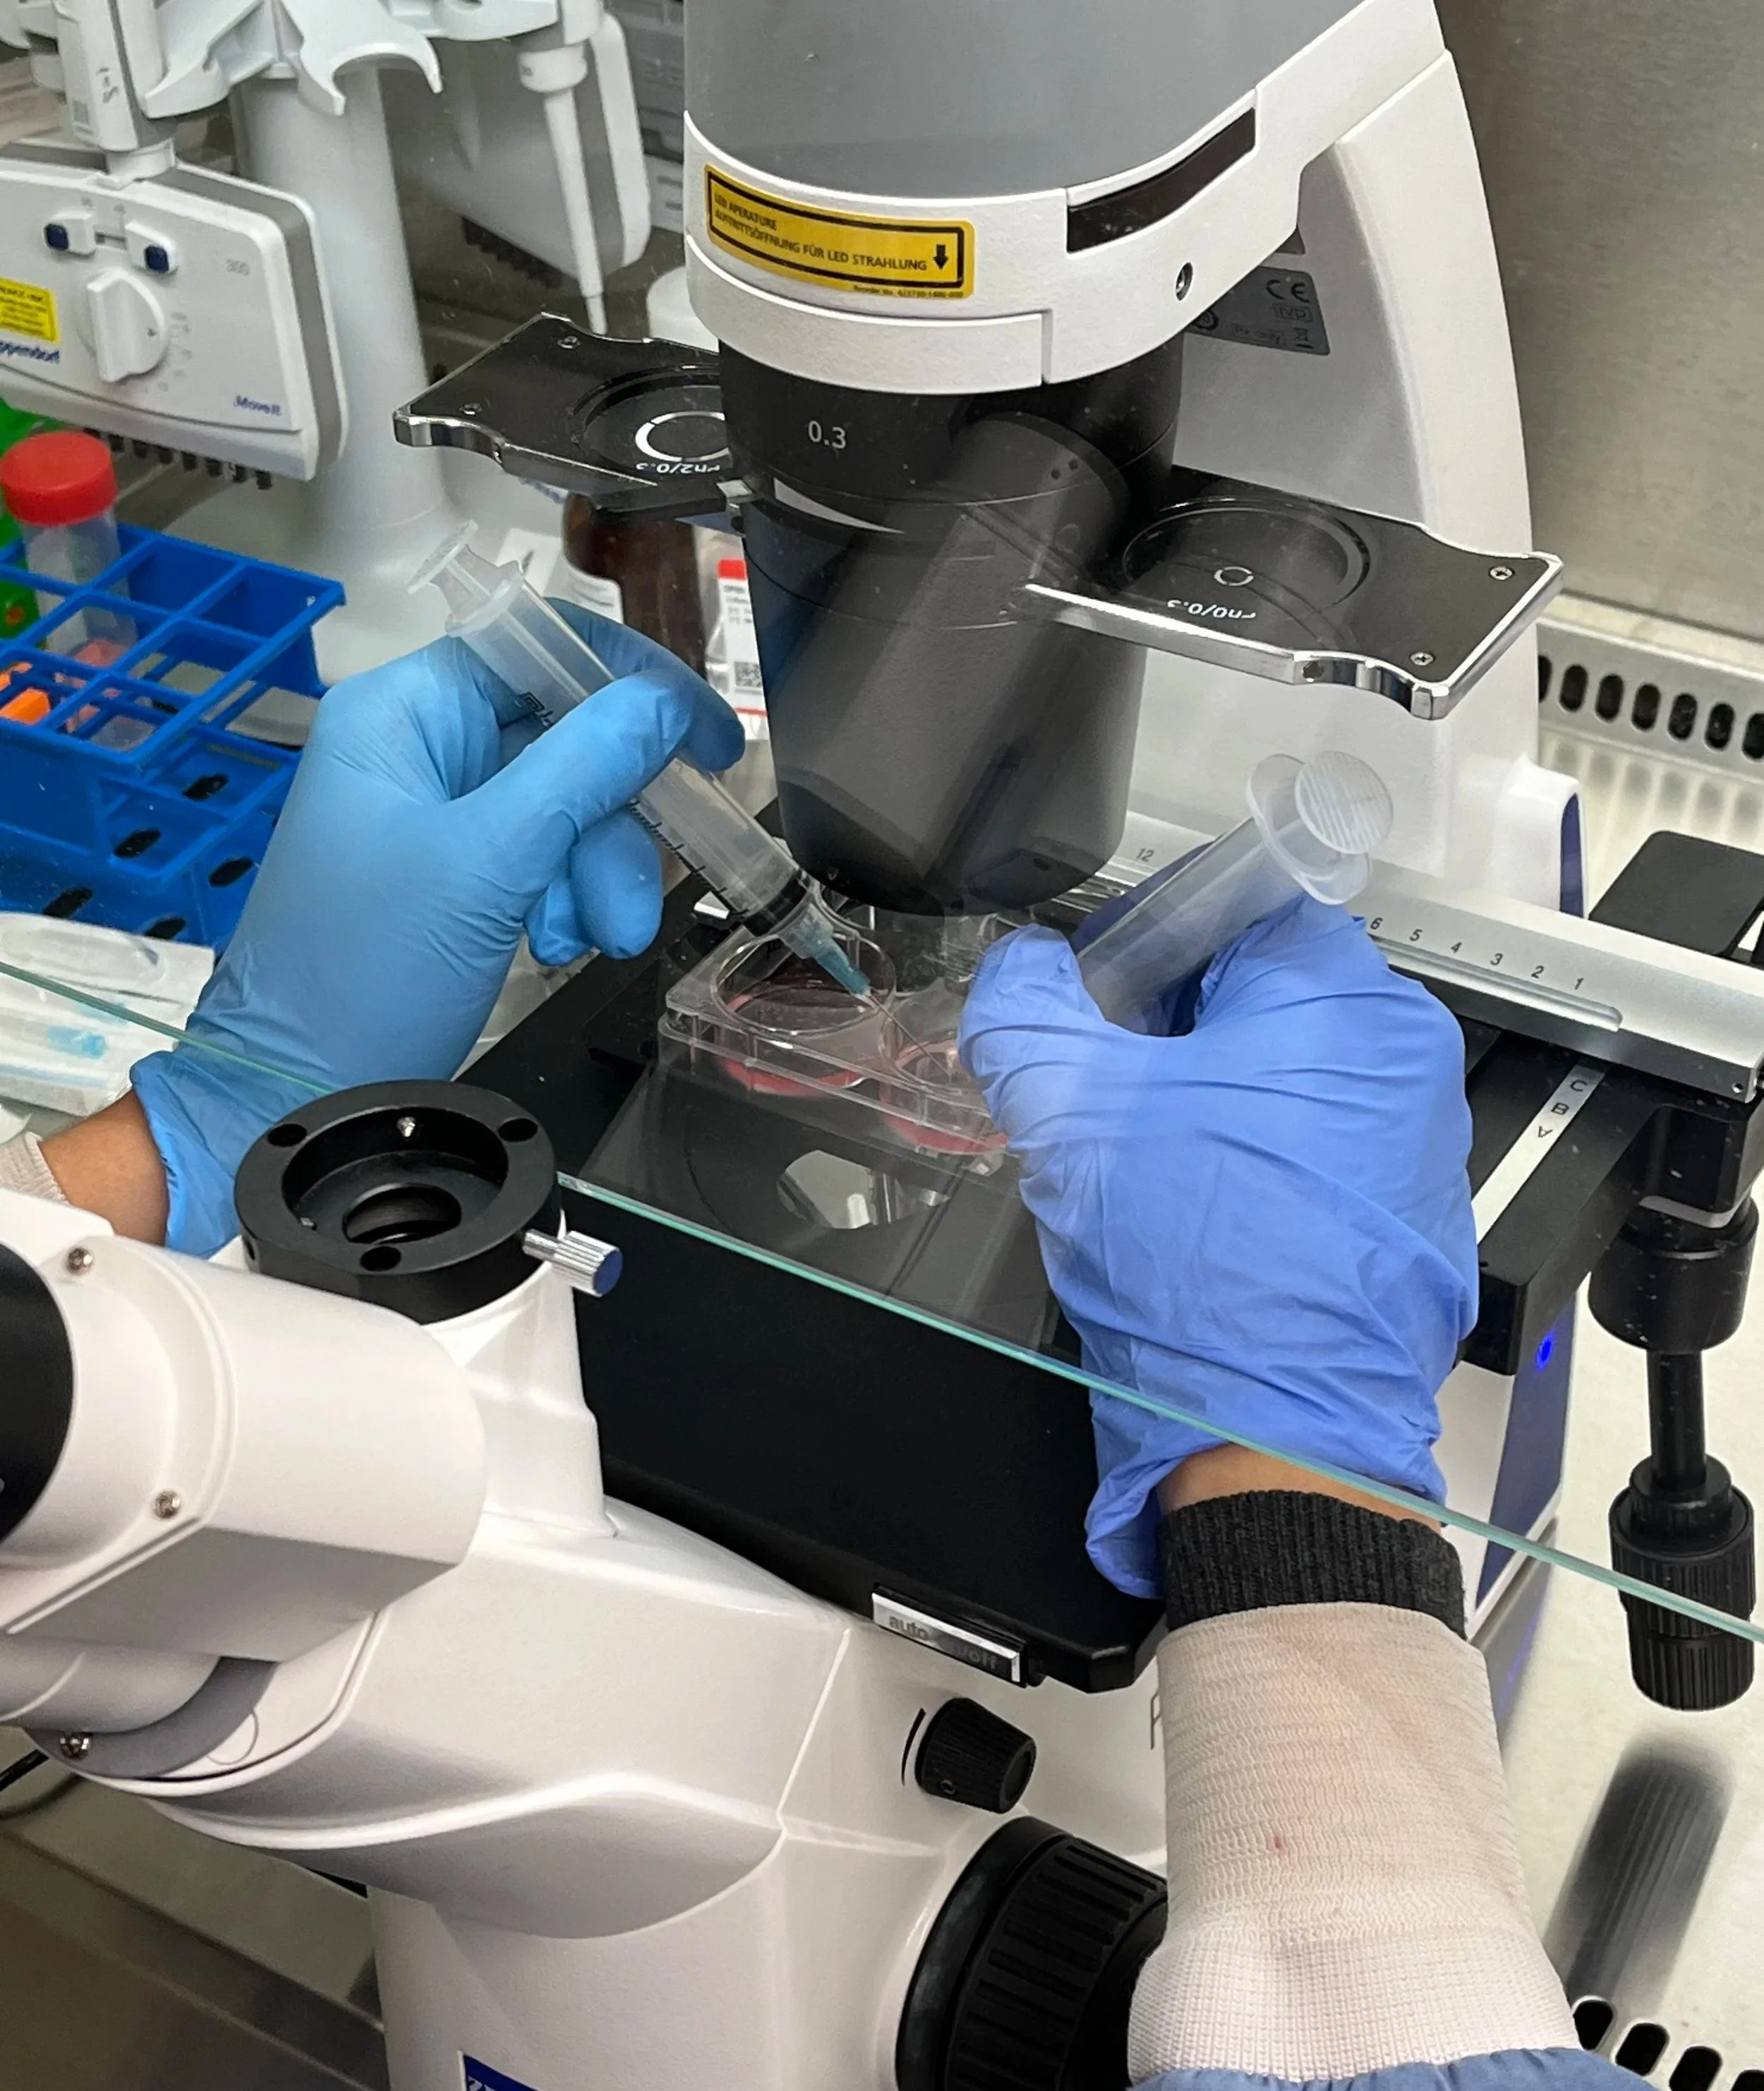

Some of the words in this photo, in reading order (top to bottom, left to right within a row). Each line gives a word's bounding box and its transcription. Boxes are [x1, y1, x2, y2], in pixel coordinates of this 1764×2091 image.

[715, 192, 727, 208] LED
[729, 202, 777, 231] APERATURE
[803, 243, 825, 258] FÜR
[827, 250, 849, 263] LED
[852, 254, 927, 271] STRAHLUNG
[808, 420, 847, 450] 0.3
[1136, 848, 1155, 862] 12
[1370, 917, 1383, 930] 6
[1409, 928, 1422, 941] 5
[1451, 941, 1463, 953] 4
[1490, 953, 1504, 966] 3
[1531, 965, 1545, 979] 2
[1574, 977, 1584, 990] 1
[889, 1615, 929, 1641] auto
